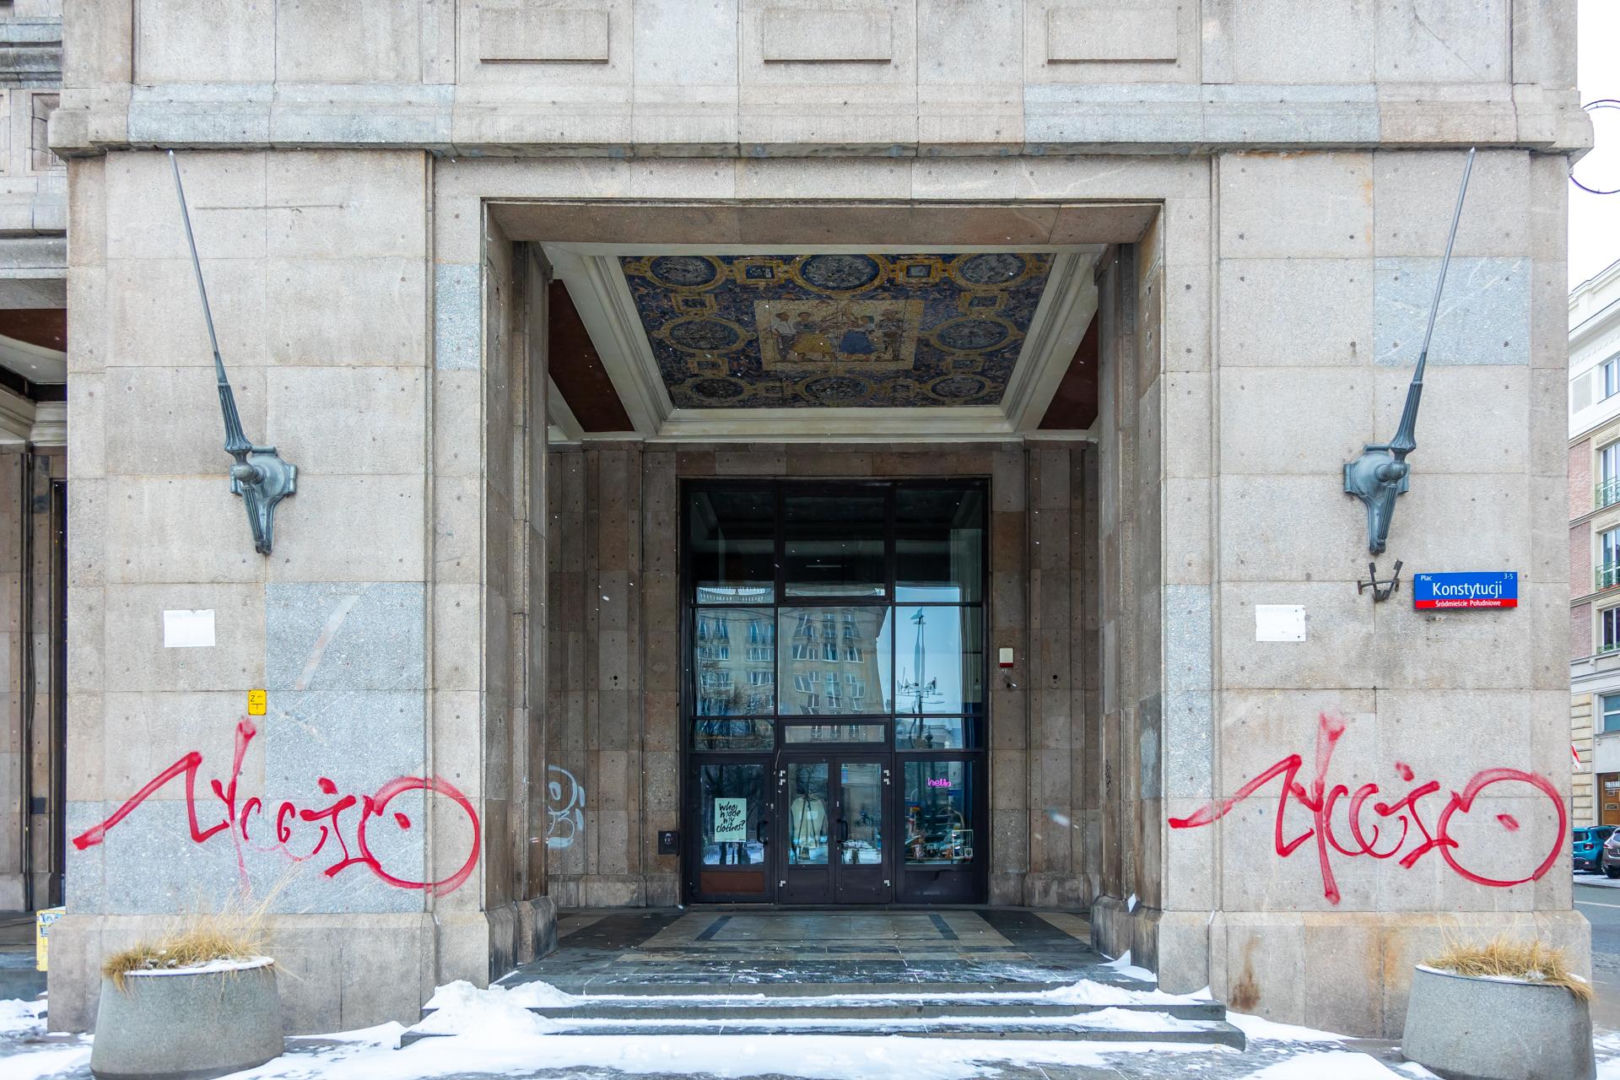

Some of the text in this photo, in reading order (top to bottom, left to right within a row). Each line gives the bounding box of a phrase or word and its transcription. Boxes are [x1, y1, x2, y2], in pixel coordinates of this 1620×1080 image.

[1432, 581, 1503, 599] Konstytucji
[1435, 599, 1468, 607] Śródmieście
[927, 777, 952, 787] hello
